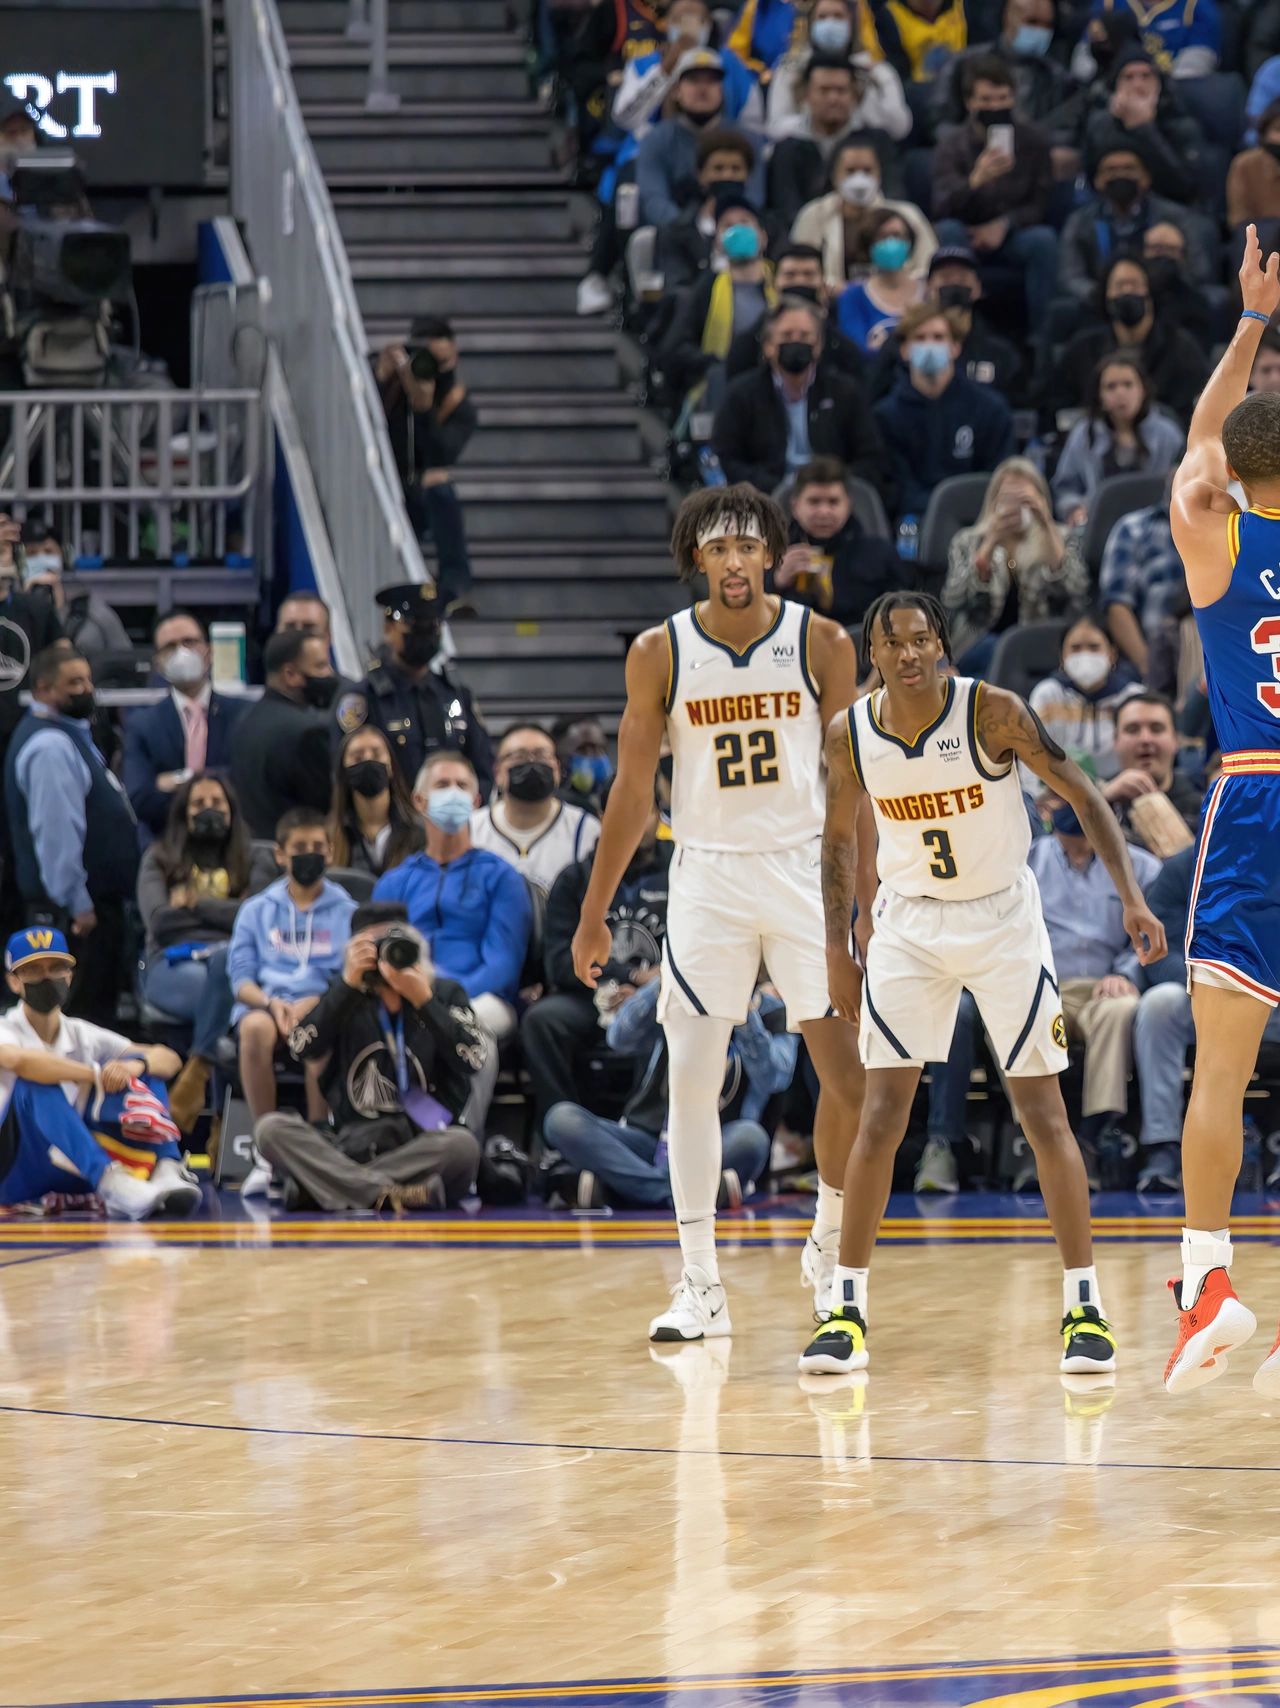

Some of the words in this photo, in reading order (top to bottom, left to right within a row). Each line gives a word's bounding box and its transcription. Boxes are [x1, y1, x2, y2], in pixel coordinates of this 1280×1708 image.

[772, 645, 794, 657] WU
[685, 691, 801, 727] NUGGETS
[713, 729, 780, 790] 22
[936, 737, 960, 751] WU
[874, 784, 984, 822] NUGGETS
[921, 828, 958, 880] 3
[25, 929, 53, 949] W
